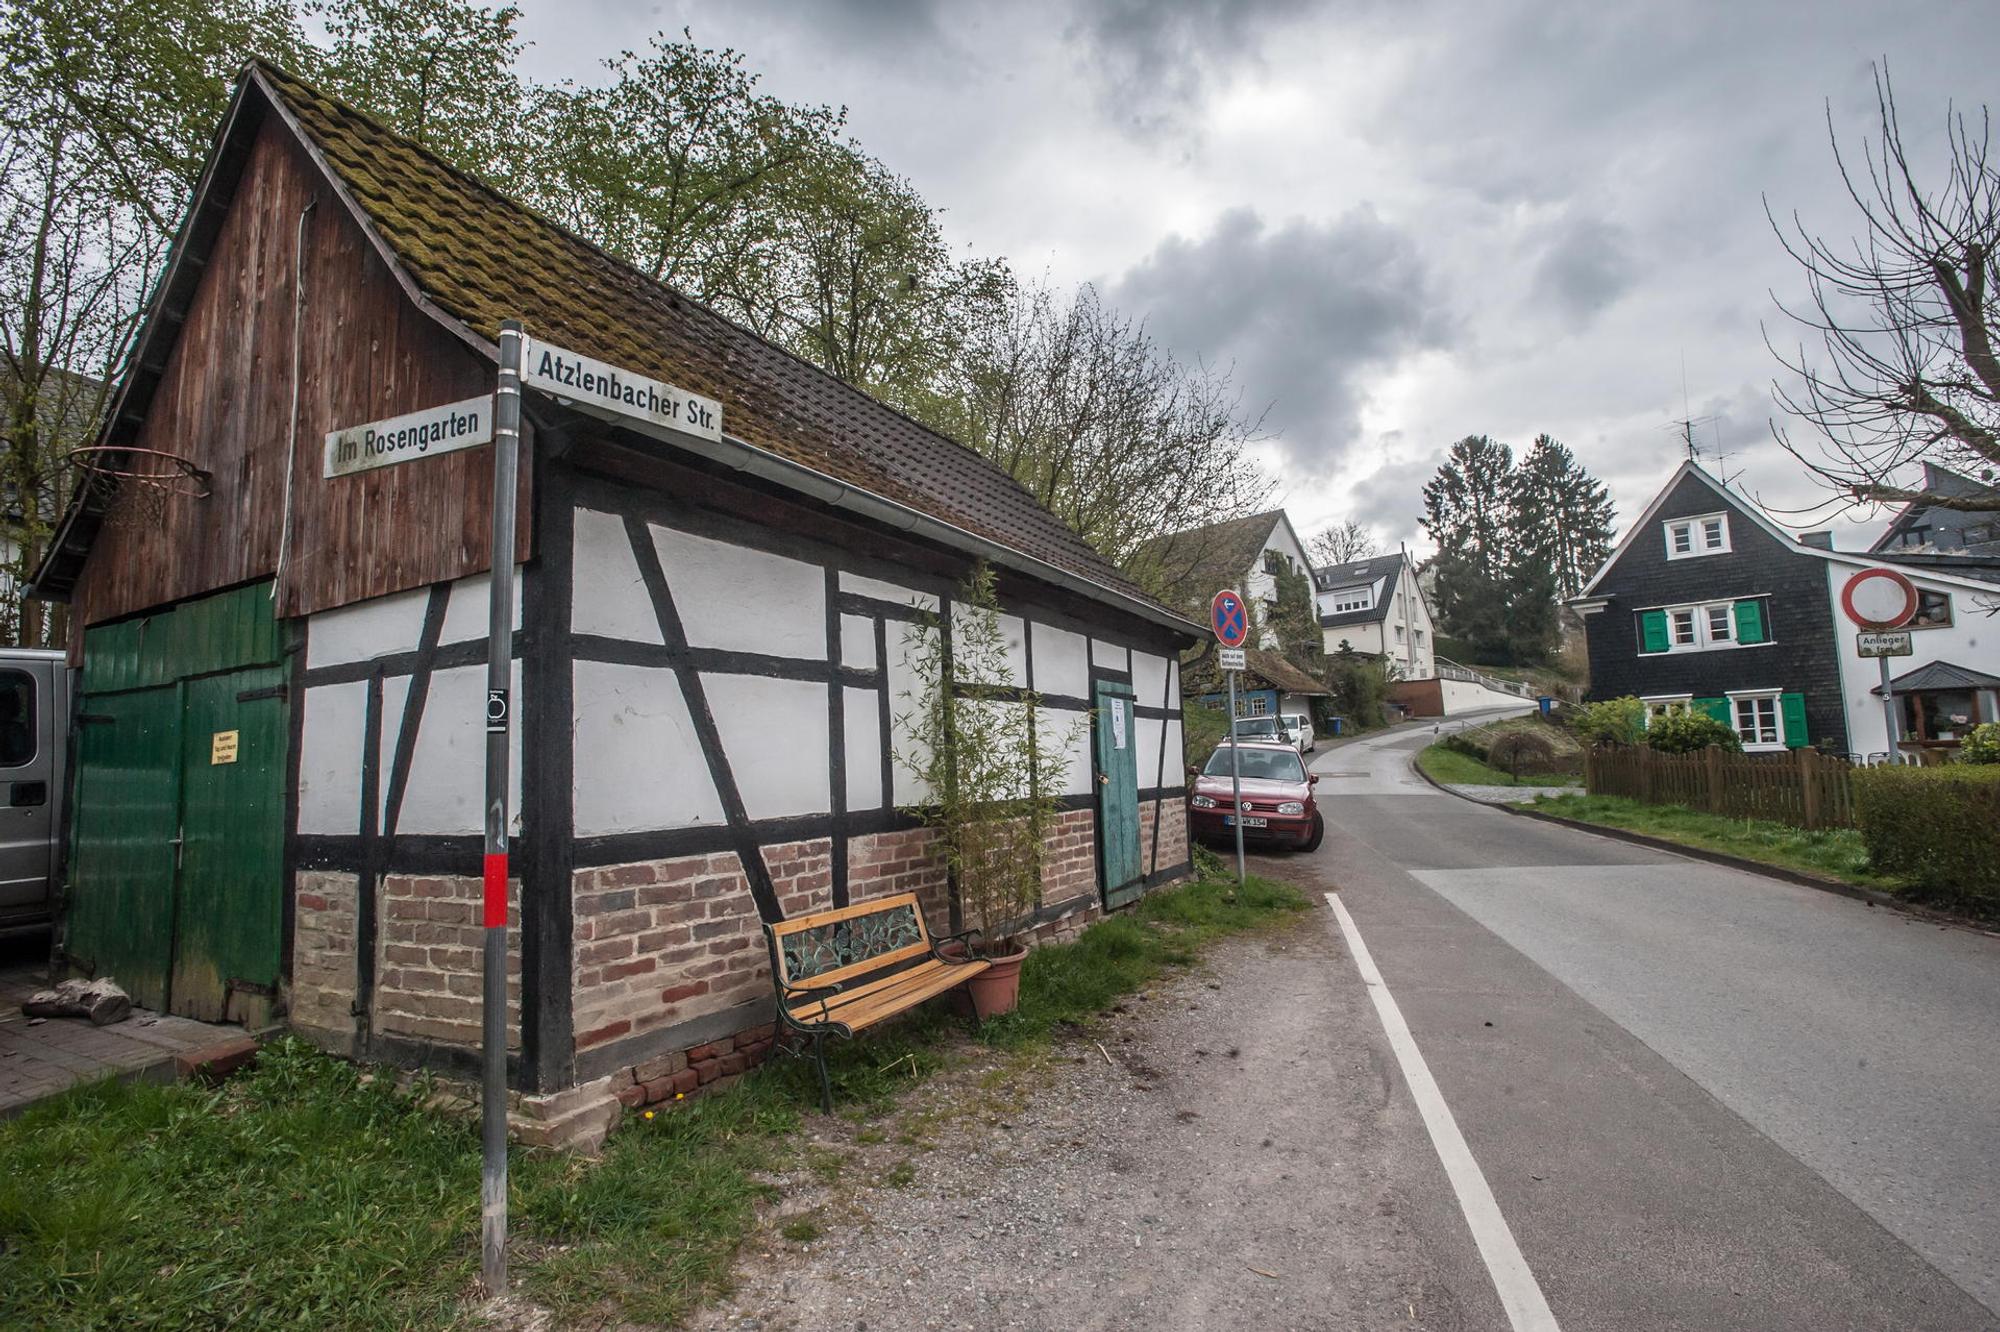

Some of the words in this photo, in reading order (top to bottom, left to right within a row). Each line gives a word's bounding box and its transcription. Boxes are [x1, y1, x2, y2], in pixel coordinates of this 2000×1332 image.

[538, 350, 680, 419] Atzlenbacher
[687, 400, 714, 430] Str.
[337, 436, 358, 463] Im
[365, 411, 478, 458] Rosengarten
[1863, 634, 1905, 646] Anlieger
